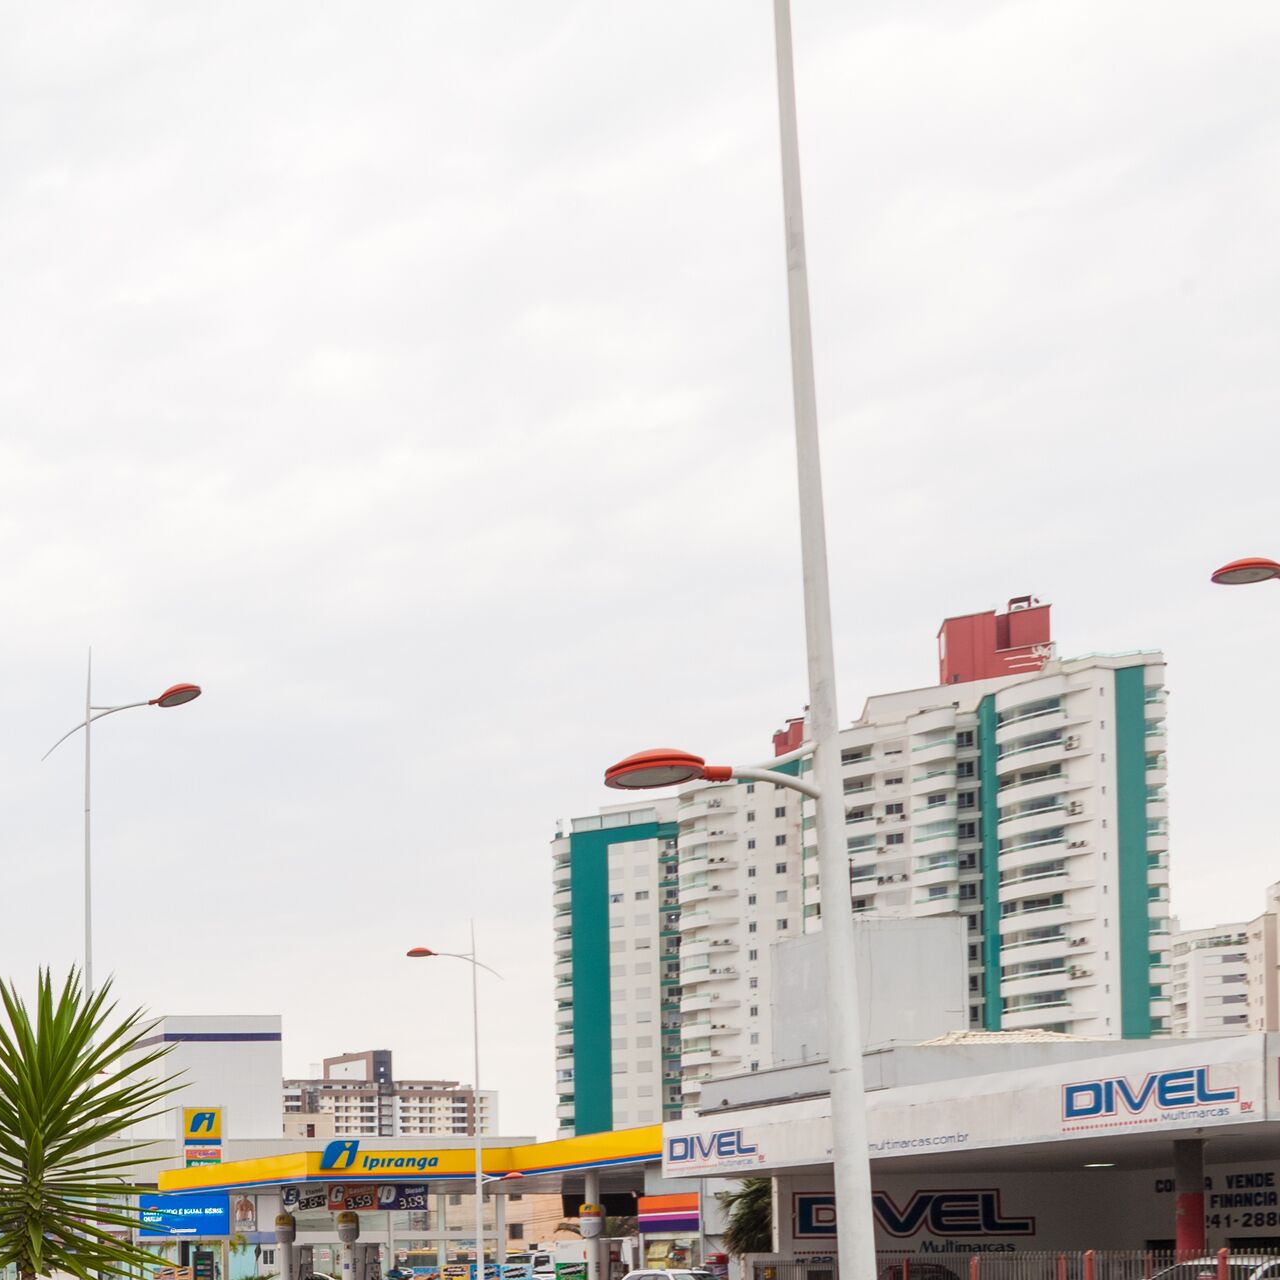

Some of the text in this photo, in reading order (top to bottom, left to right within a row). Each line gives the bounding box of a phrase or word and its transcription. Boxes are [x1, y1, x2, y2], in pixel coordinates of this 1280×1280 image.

[1064, 1067, 1237, 1119] DIVEL
[1160, 1106, 1230, 1122] Multimarcas
[668, 1130, 757, 1162] DIVEL
[362, 1155, 439, 1171] Ipiranga
[1225, 1172, 1275, 1190] VENDE
[1210, 1191, 1278, 1209] FINANCIA
[798, 1193, 1031, 1234] DVEL
[1206, 1211, 1280, 1229] 41-288
[919, 1239, 1017, 1253] Multimarcas
